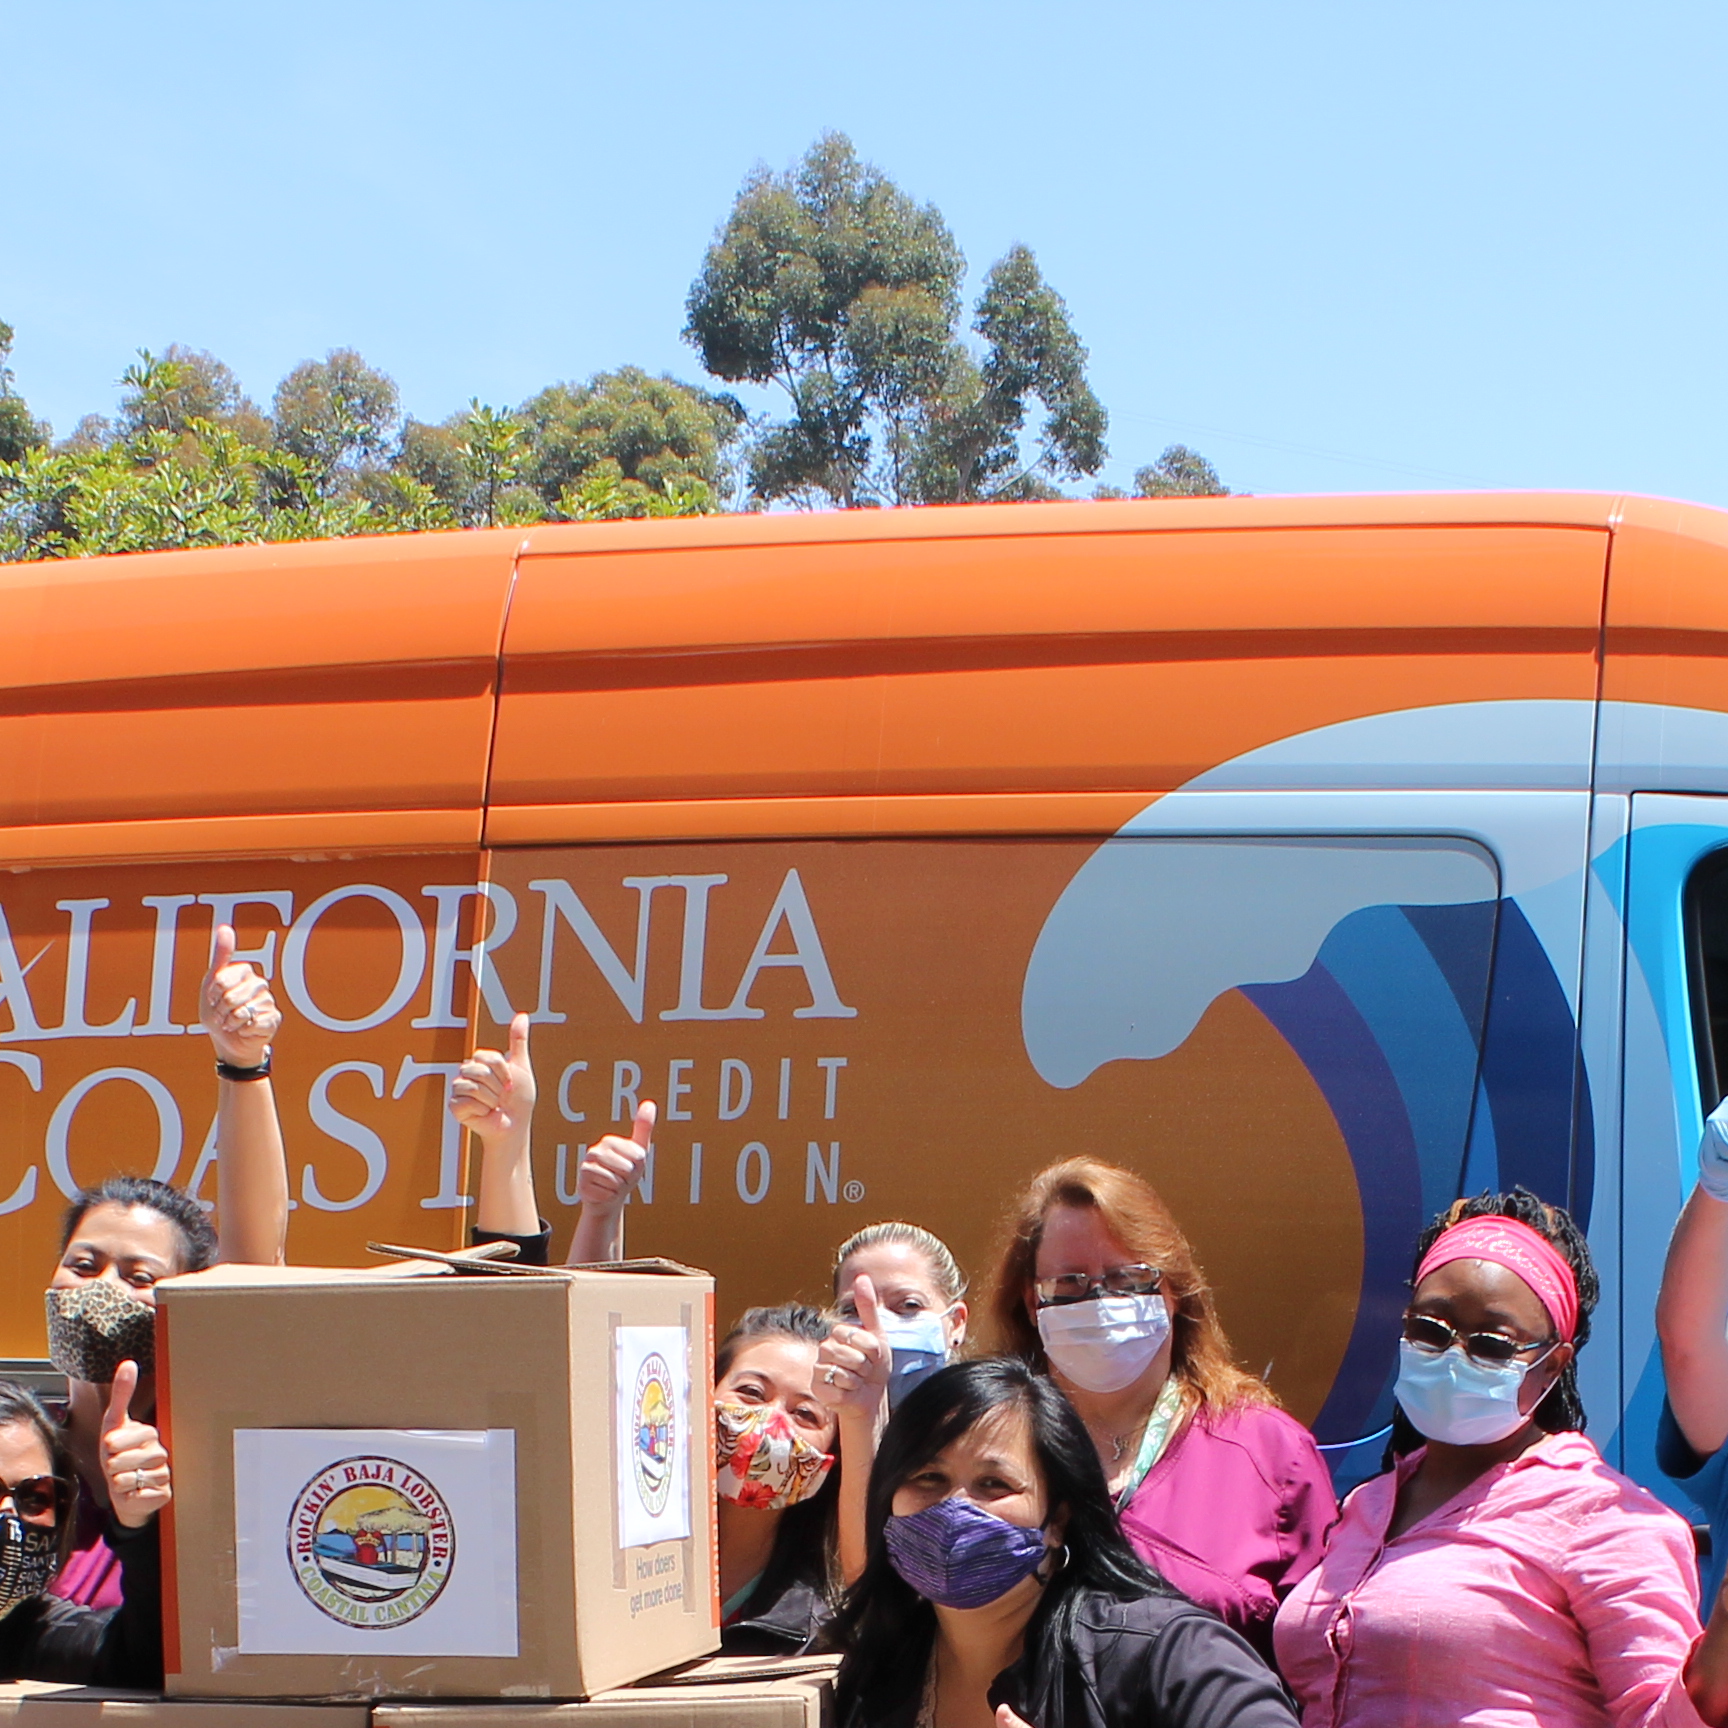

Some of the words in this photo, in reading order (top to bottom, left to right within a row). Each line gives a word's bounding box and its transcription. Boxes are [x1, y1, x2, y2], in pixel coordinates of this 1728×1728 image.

[558, 1058, 848, 1122] CREDIT
[296, 1474, 336, 1555] ROCKIN'
[343, 1464, 395, 1484] BAJA
[401, 1474, 448, 1560] LOBSTER
[300, 1566, 369, 1622] COASTAL
[374, 1570, 444, 1622] CANTINA
[636, 1557, 653, 1579] How
[654, 1553, 675, 1574] doers
[630, 1590, 642, 1618] get
[644, 1586, 662, 1609] more
